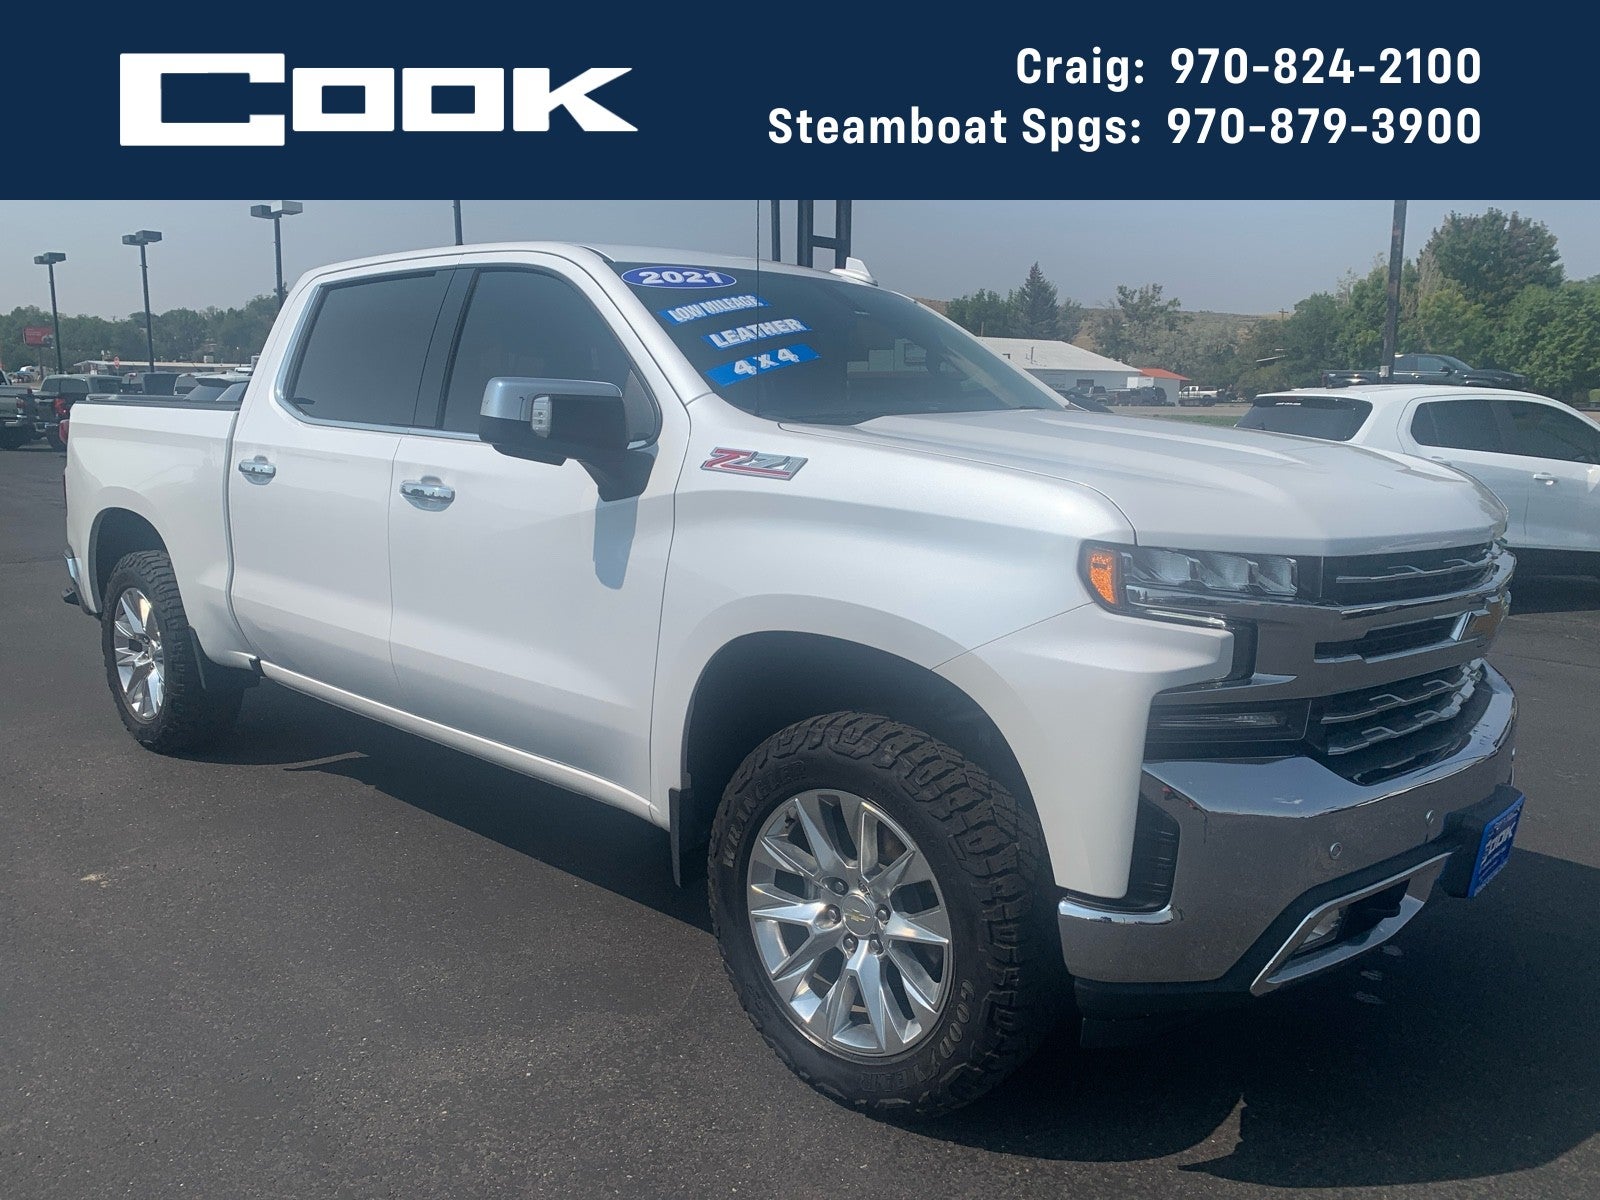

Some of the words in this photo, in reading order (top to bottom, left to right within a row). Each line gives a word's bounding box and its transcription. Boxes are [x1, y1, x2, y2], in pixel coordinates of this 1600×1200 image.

[639, 270, 724, 285] 2021
[667, 304, 707, 322] LOW
[699, 295, 764, 315] MILEAGE
[708, 318, 806, 349] LEATHER
[700, 446, 808, 481] Z71
